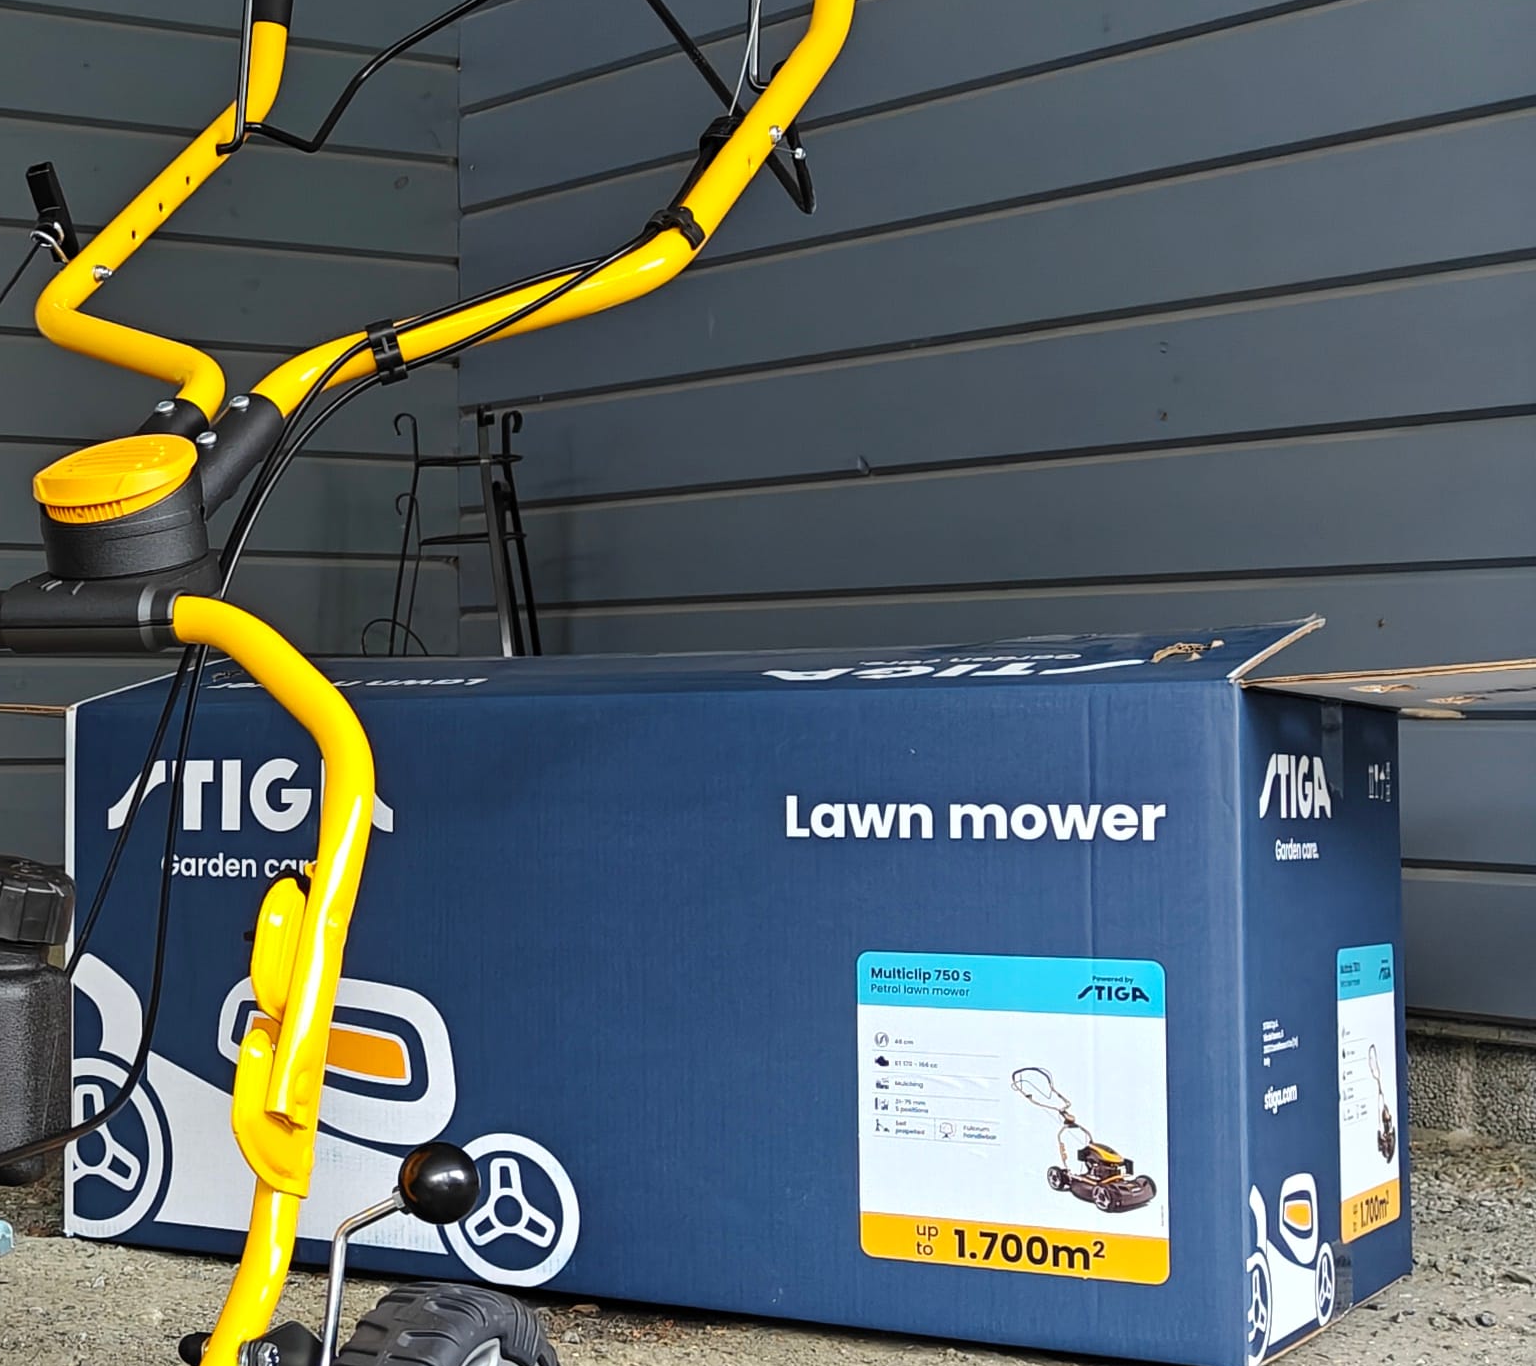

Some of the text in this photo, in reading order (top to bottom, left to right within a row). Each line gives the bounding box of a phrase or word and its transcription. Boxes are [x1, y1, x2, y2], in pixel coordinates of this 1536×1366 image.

[762, 658, 1146, 682] STIGA
[1259, 753, 1332, 819] STIGA
[785, 794, 1167, 842] Lawn mower
[1275, 838, 1301, 861] Garden
[870, 967, 972, 984] Multiclip 750 S
[1124, 976, 1135, 985] by
[870, 983, 970, 997] Petrol lawn mower
[1077, 985, 1150, 1002] STIGA
[1264, 1084, 1298, 1115] stiga.com
[900, 1106, 929, 1115] positions
[916, 1224, 1106, 1271] up 1.700m²
[916, 1241, 934, 1256] to
